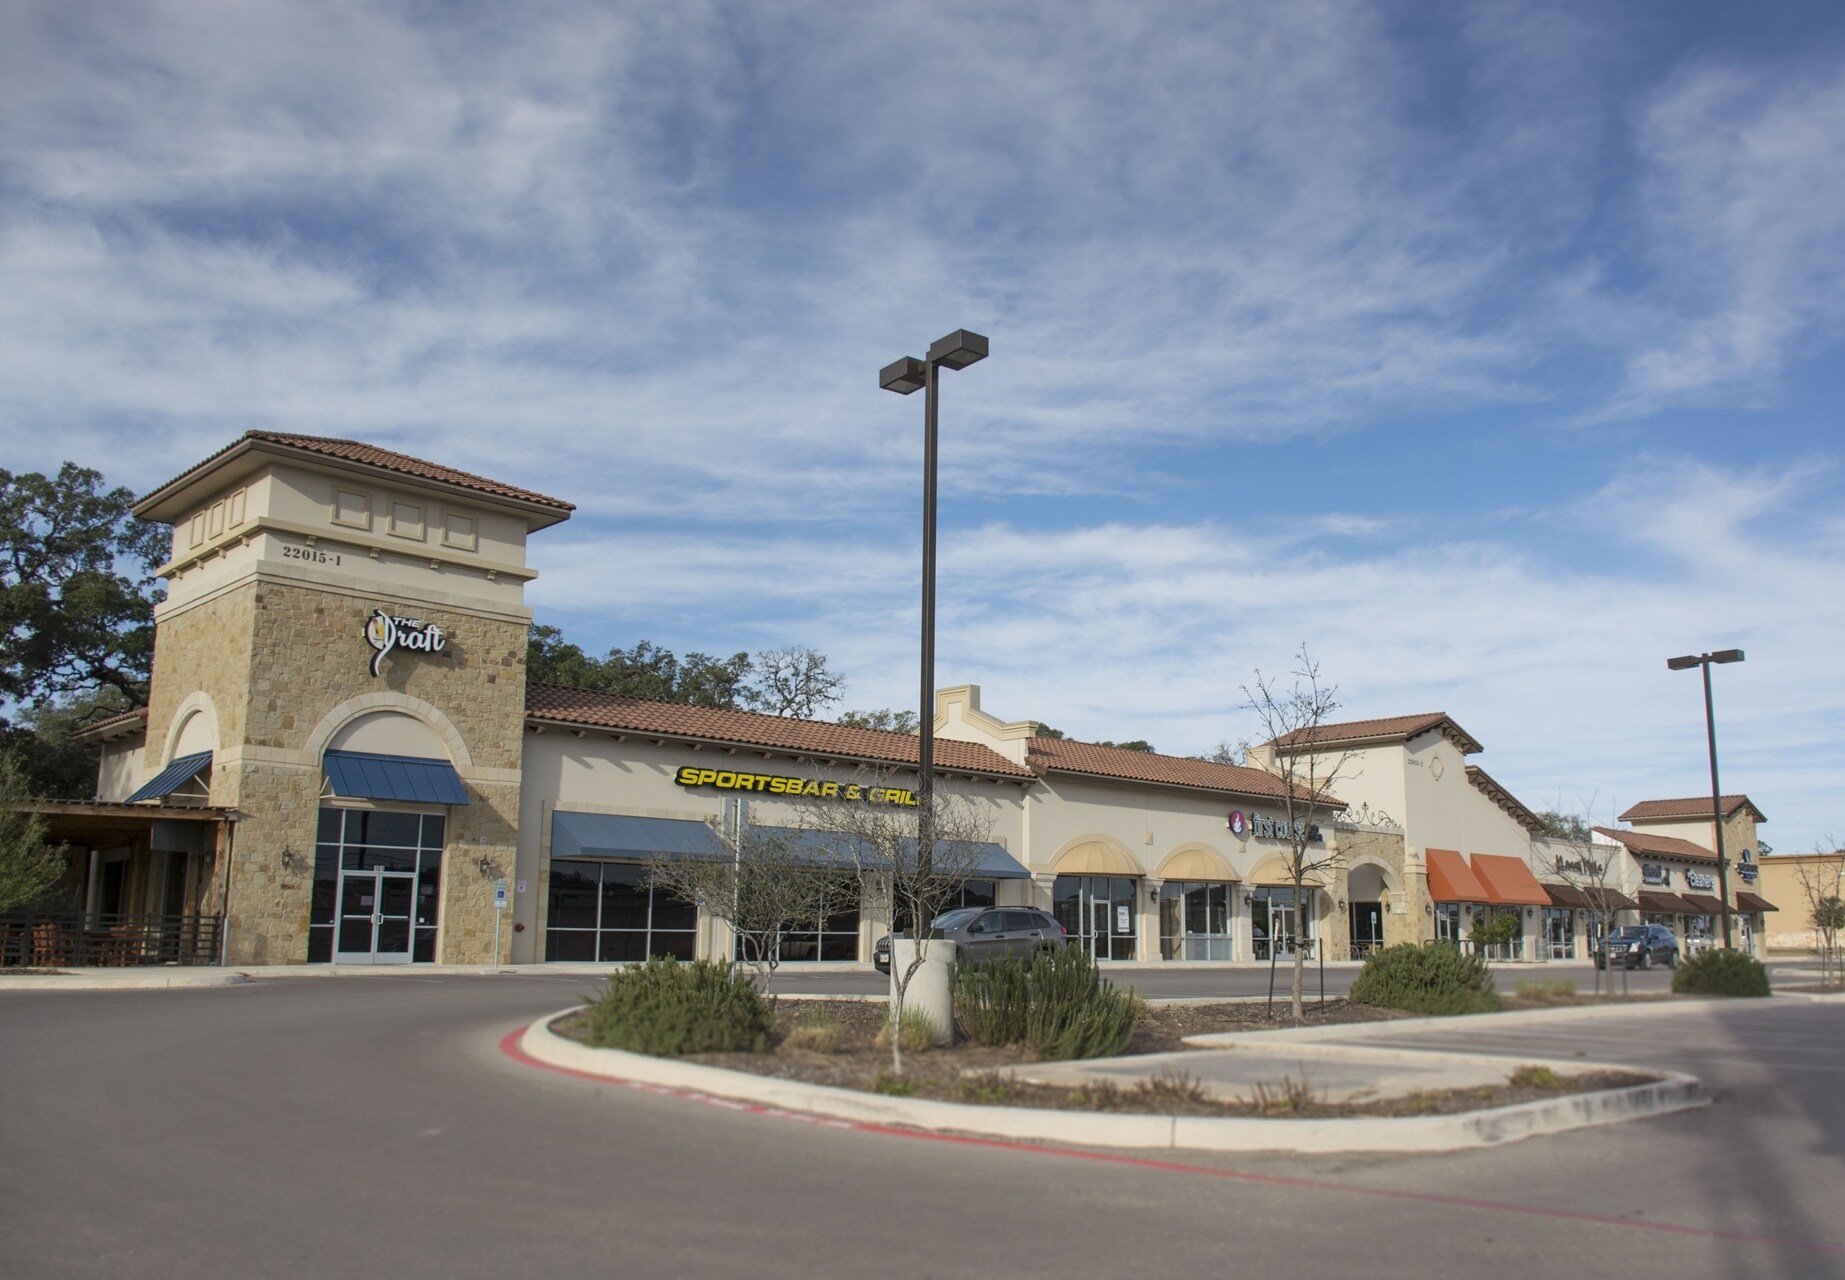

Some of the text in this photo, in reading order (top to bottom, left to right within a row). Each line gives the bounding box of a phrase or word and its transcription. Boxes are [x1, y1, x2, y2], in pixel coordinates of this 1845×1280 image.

[283, 546, 341, 566] 22015-1
[393, 617, 421, 628] THE
[373, 609, 446, 676] Draft
[680, 768, 919, 806] SPORTSBAR & GRIL
[1252, 812, 1274, 838] first
